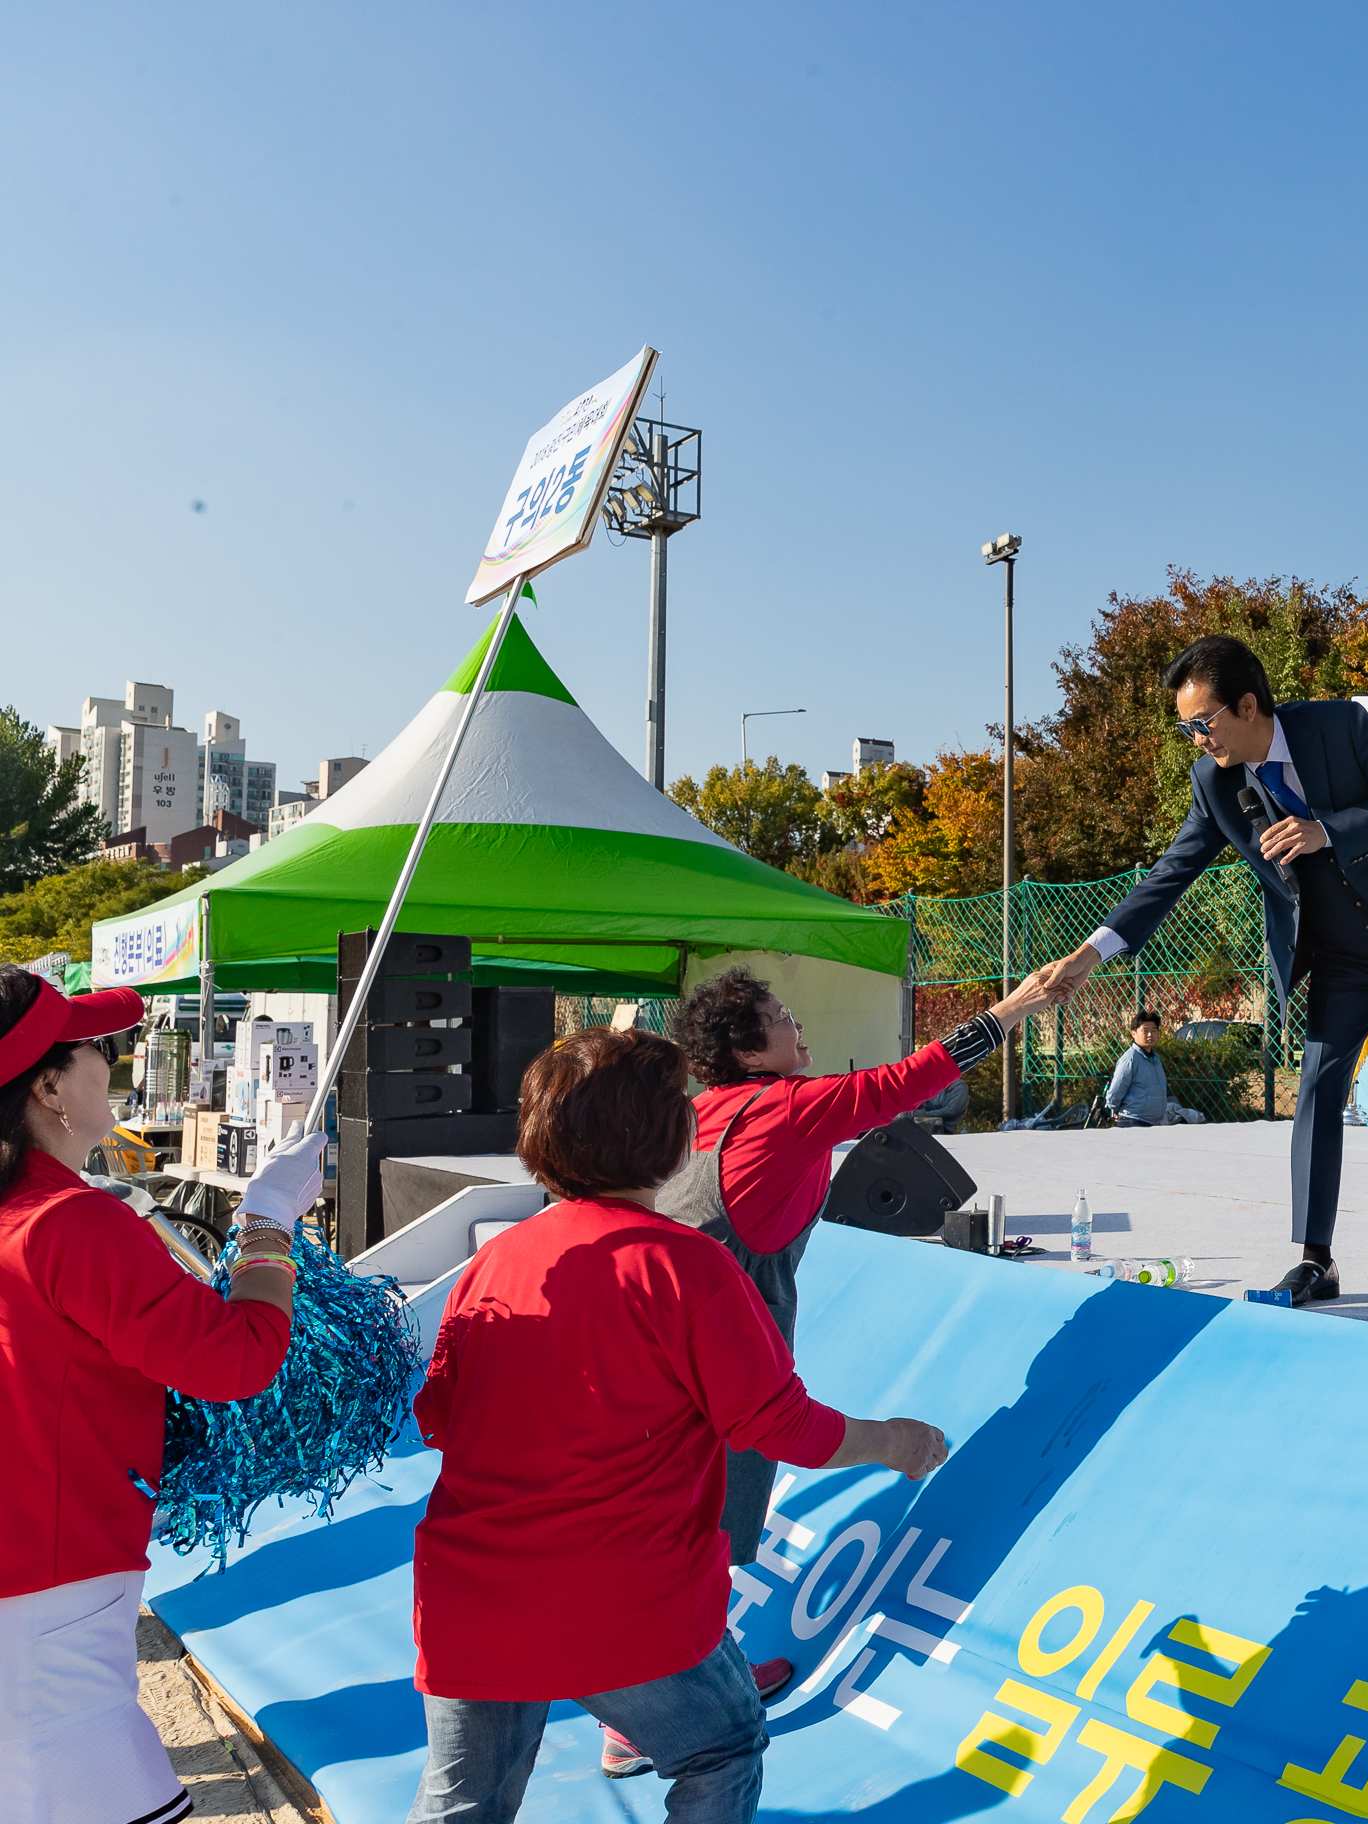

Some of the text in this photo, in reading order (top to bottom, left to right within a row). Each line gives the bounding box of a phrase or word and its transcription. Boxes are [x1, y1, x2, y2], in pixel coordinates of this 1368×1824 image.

[503, 443, 593, 548] 구의2동
[156, 799, 172, 808] 103
[955, 1585, 1274, 1824] 일류
